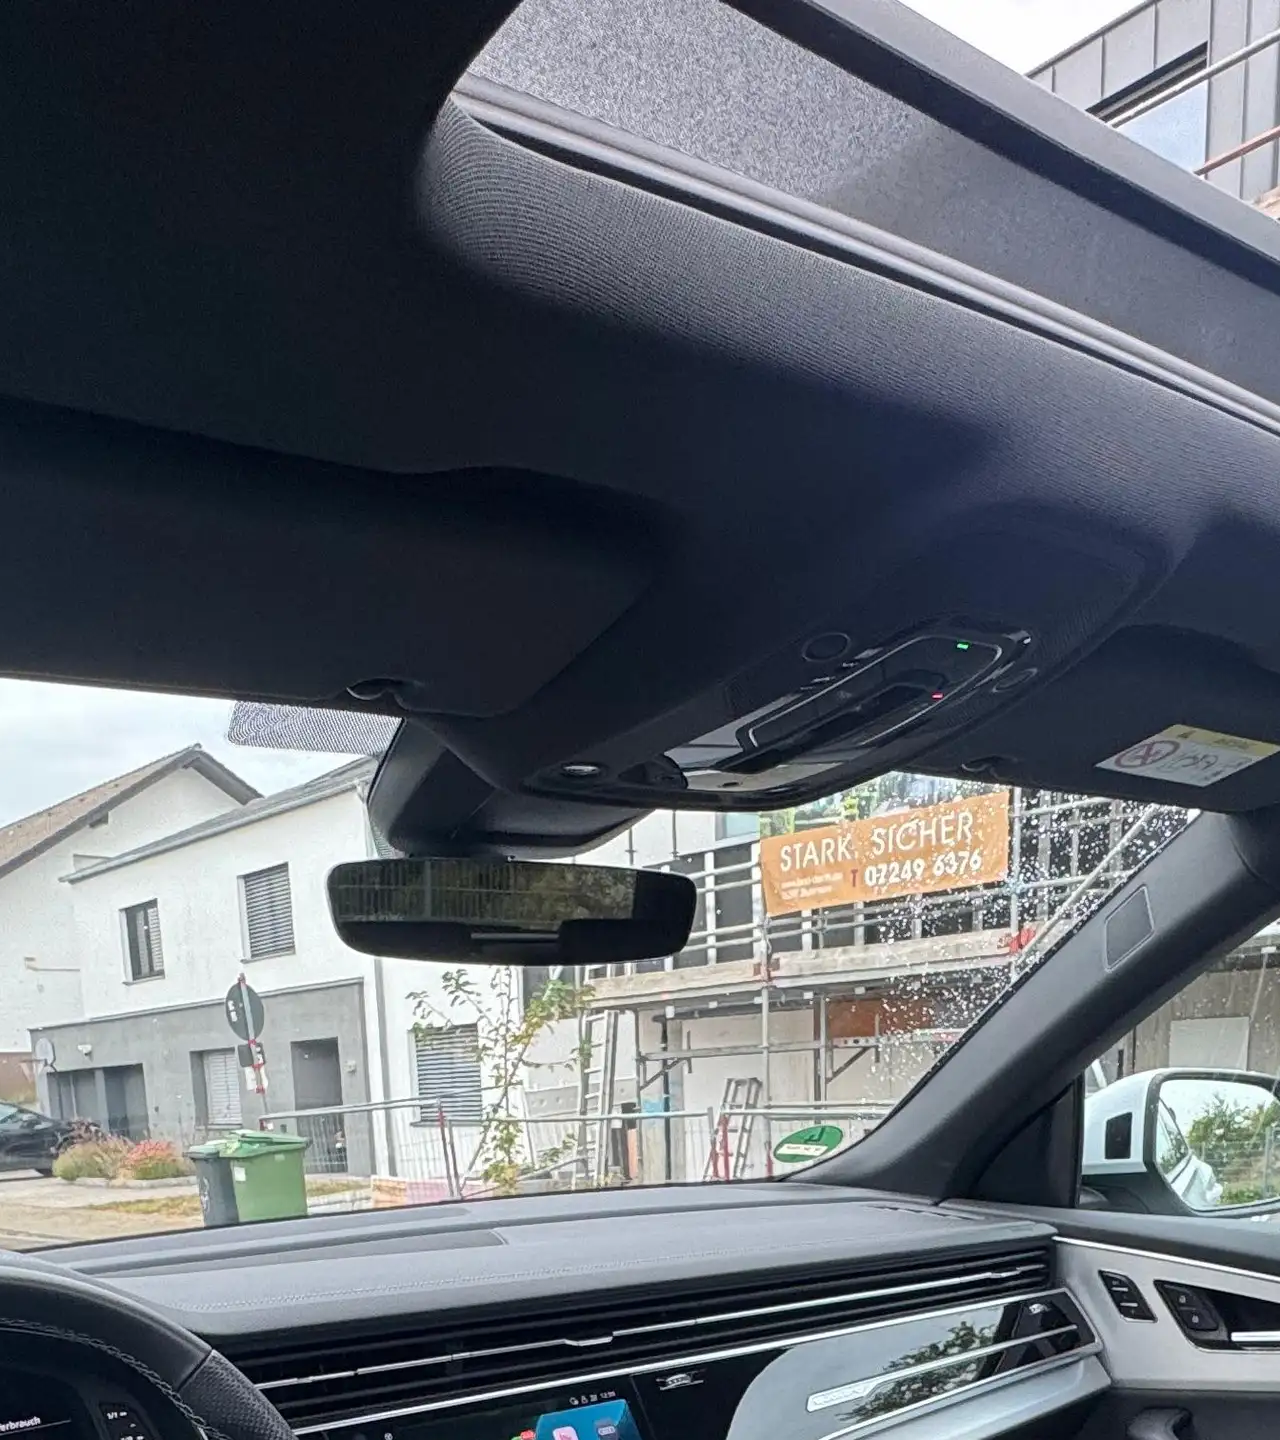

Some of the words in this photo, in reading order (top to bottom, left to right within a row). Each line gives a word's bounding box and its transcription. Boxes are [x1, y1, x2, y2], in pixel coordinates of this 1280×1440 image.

[871, 811, 974, 856] SICHER
[864, 858, 927, 887] 07249
[932, 849, 982, 877] 6376
